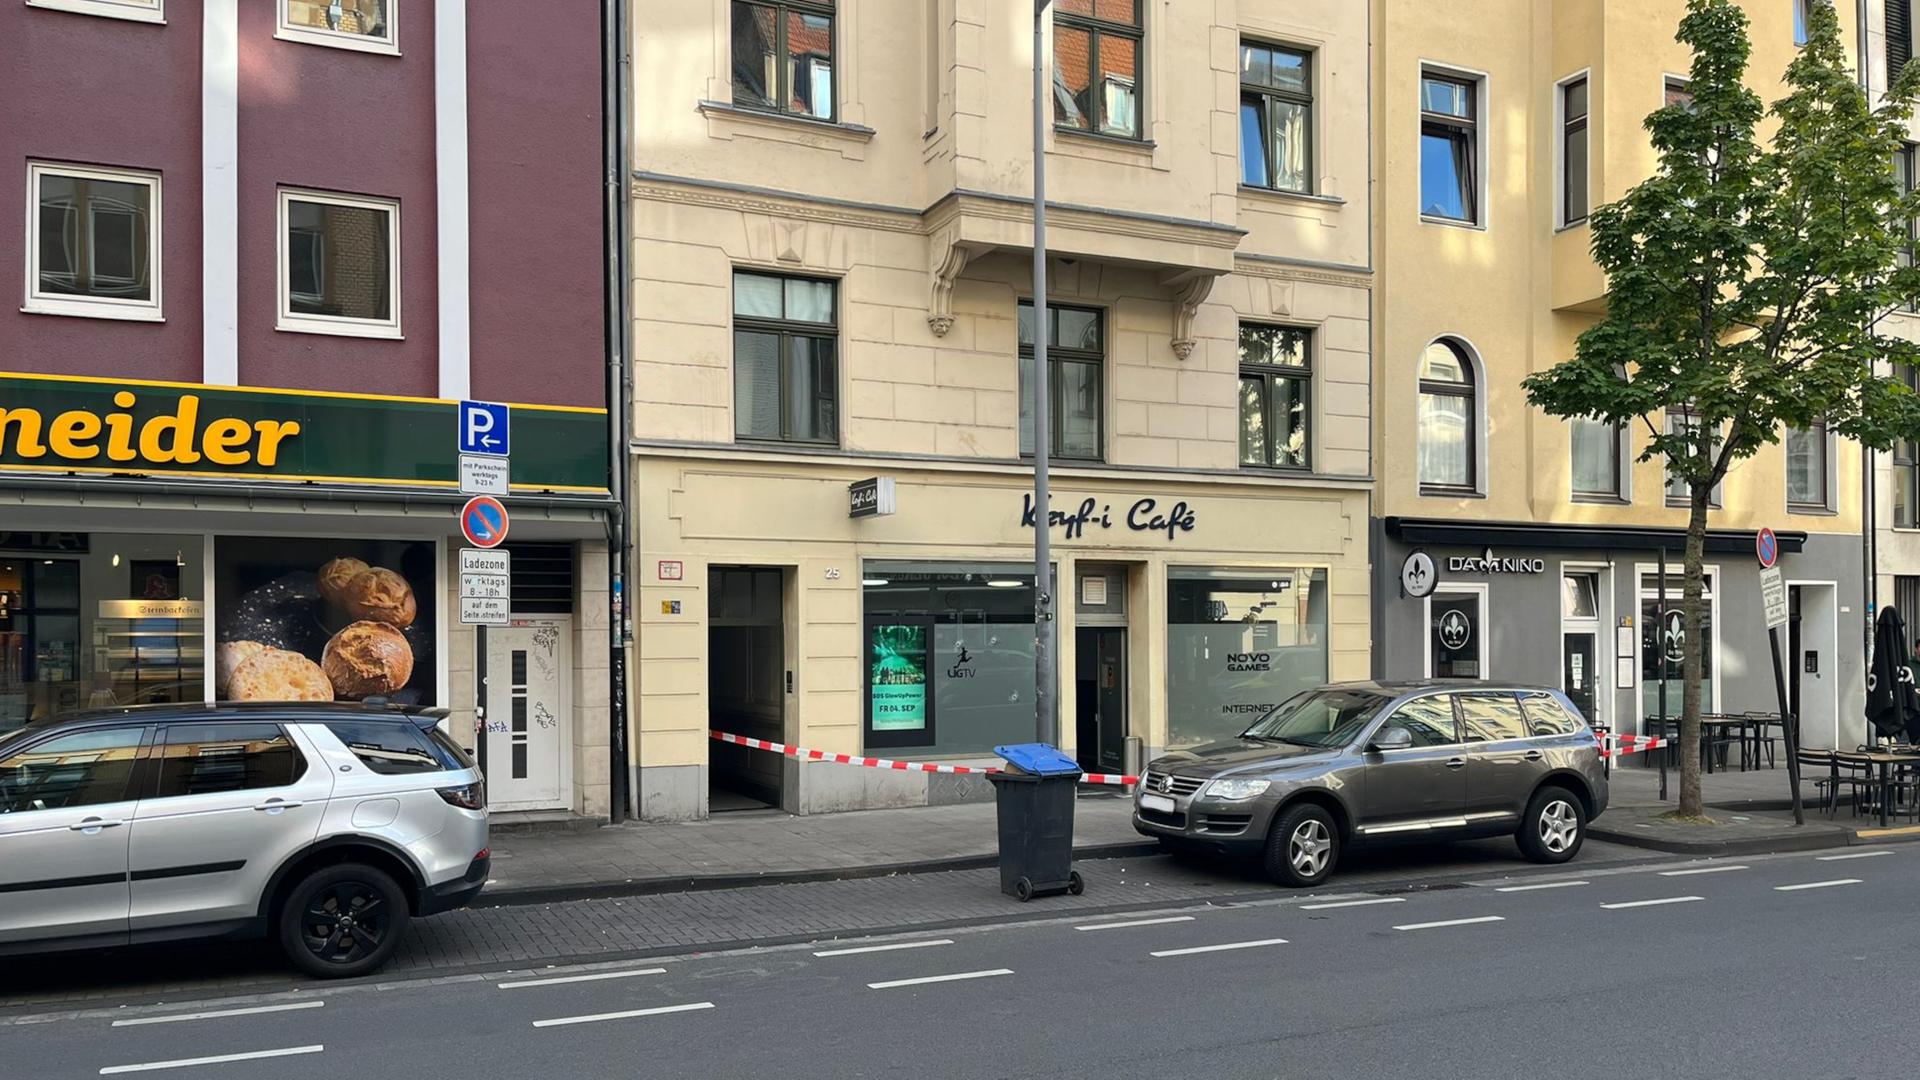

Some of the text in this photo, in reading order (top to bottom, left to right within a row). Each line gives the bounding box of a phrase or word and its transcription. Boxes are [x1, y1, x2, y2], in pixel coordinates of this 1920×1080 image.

[0, 391, 300, 466] neider
[468, 408, 494, 446] P
[474, 463, 507, 472] Parkschein
[1127, 498, 1195, 540] Café
[464, 557, 505, 570] Ladezone
[1450, 556, 1544, 572] DA NINO
[826, 567, 840, 579] 25
[464, 576, 505, 588] wrktags
[470, 588, 475, 596] 8
[486, 588, 500, 596] 18h
[1227, 653, 1270, 663] NOVO
[1222, 704, 1275, 714] INTERNET
